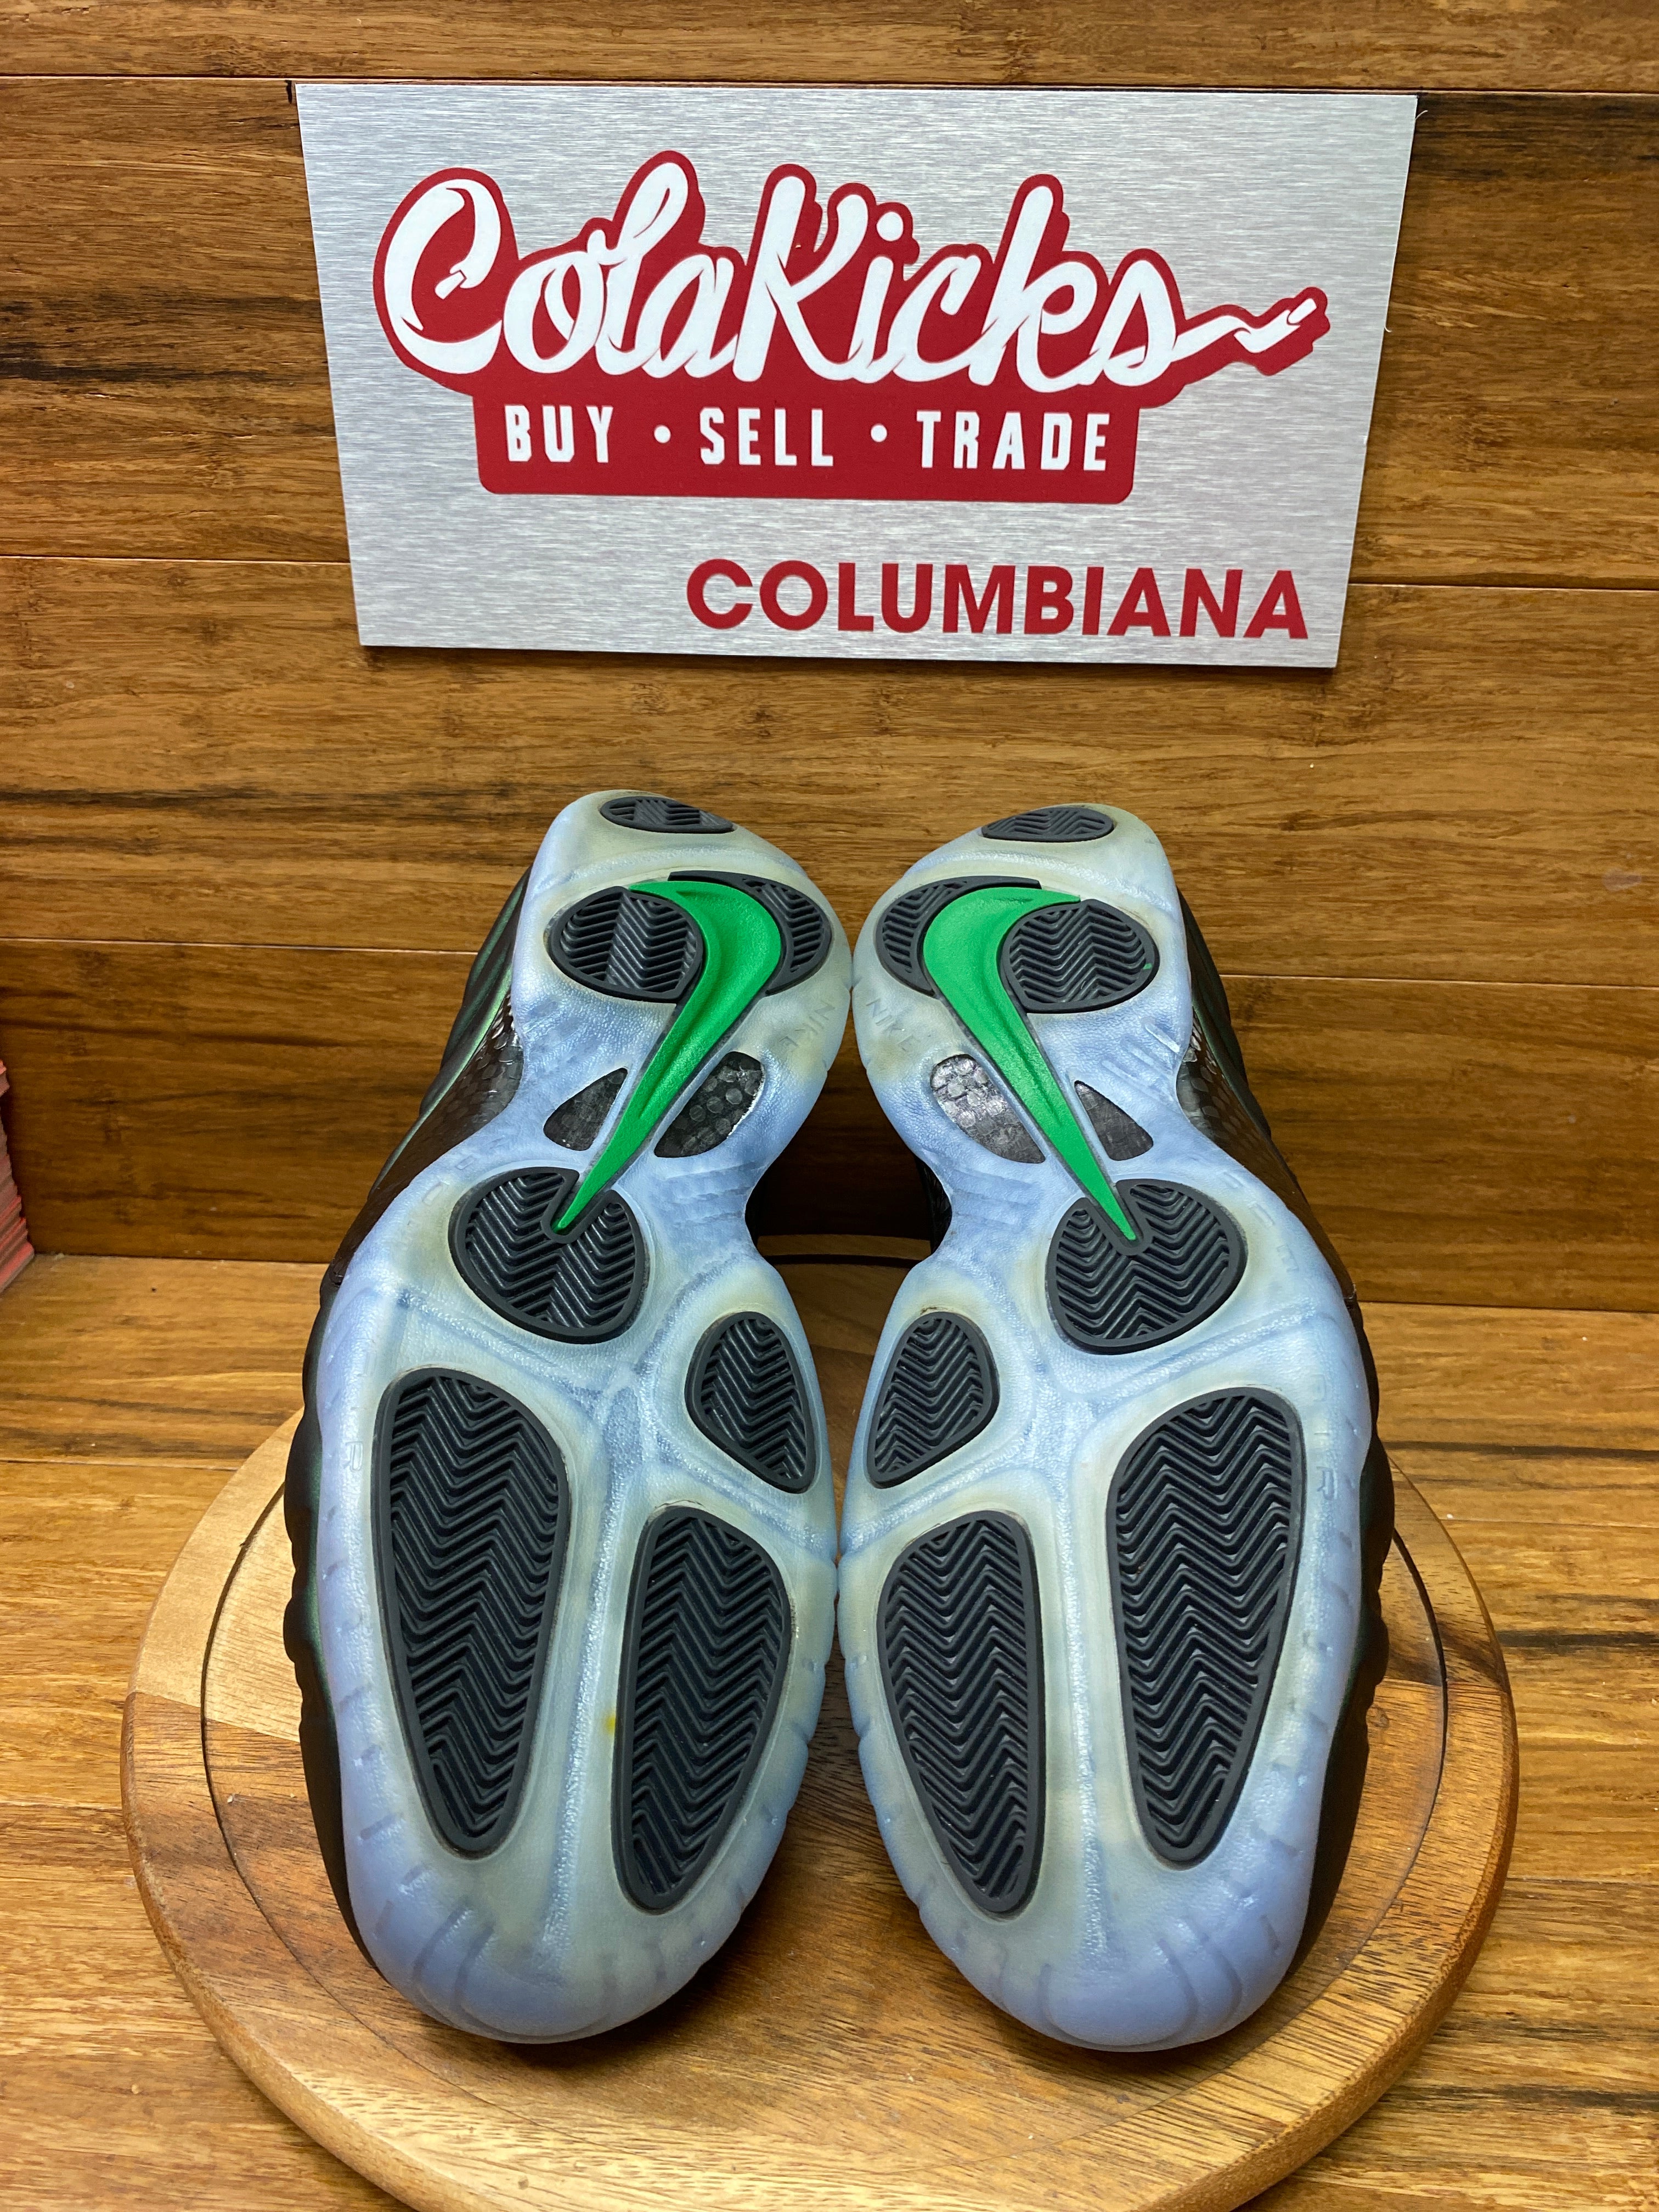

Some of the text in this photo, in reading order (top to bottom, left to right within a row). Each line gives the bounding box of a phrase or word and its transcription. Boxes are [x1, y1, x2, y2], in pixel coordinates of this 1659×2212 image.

[384, 162, 1317, 393] ColaKicks
[505, 404, 1110, 471] BUY SELL TRADE
[687, 558, 1308, 639] COLUMBIANA
[779, 1000, 836, 1051] NIKE
[866, 998, 923, 1052] NIKE
